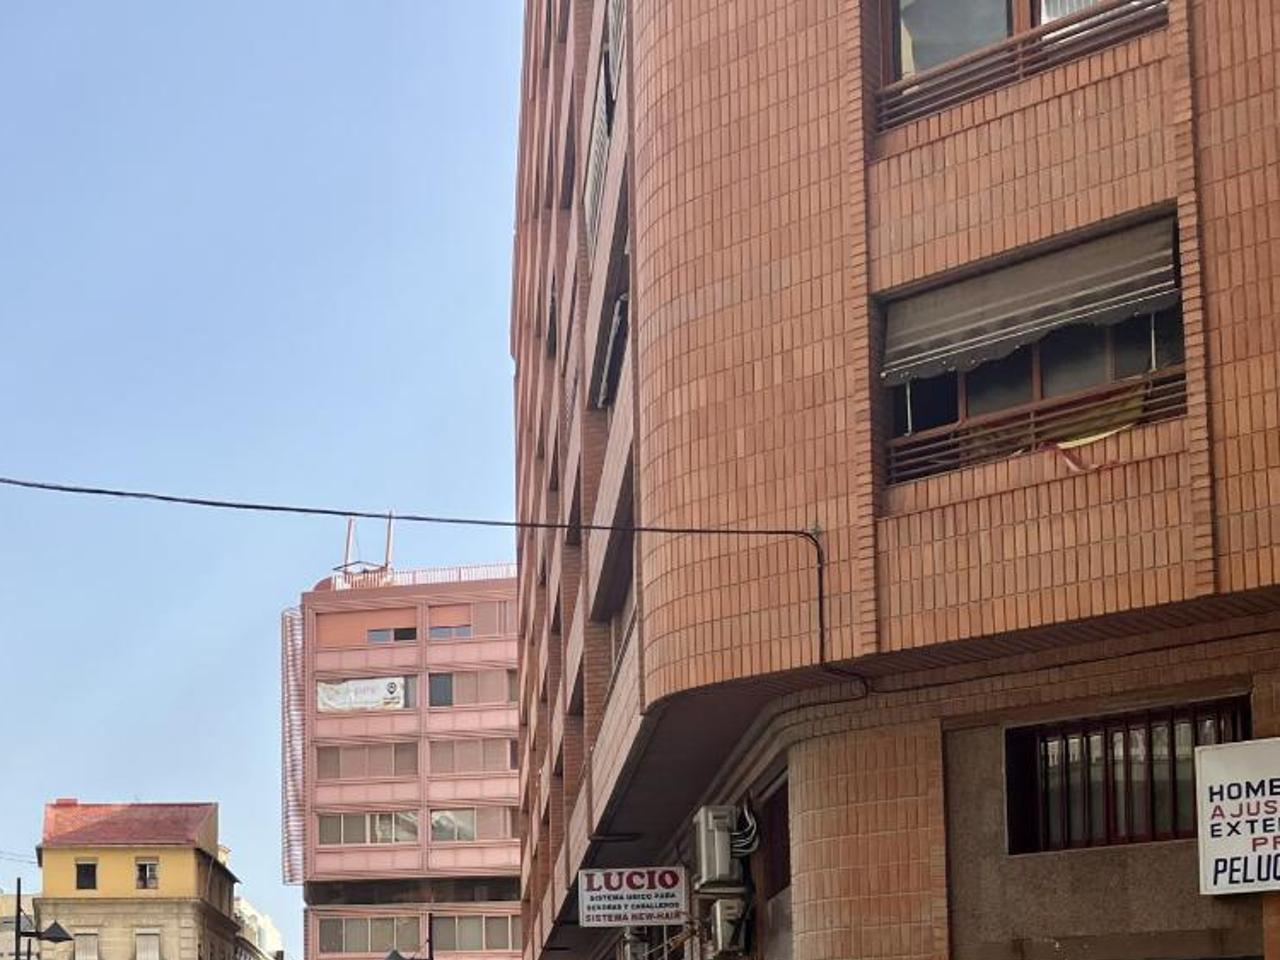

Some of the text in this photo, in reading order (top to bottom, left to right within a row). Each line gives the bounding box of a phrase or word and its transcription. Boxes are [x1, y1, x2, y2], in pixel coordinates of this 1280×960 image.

[1208, 777, 1280, 803] HOME
[1210, 817, 1280, 838] EXTE
[584, 870, 680, 892] LUCIO
[585, 914, 629, 923] SISTEMA
